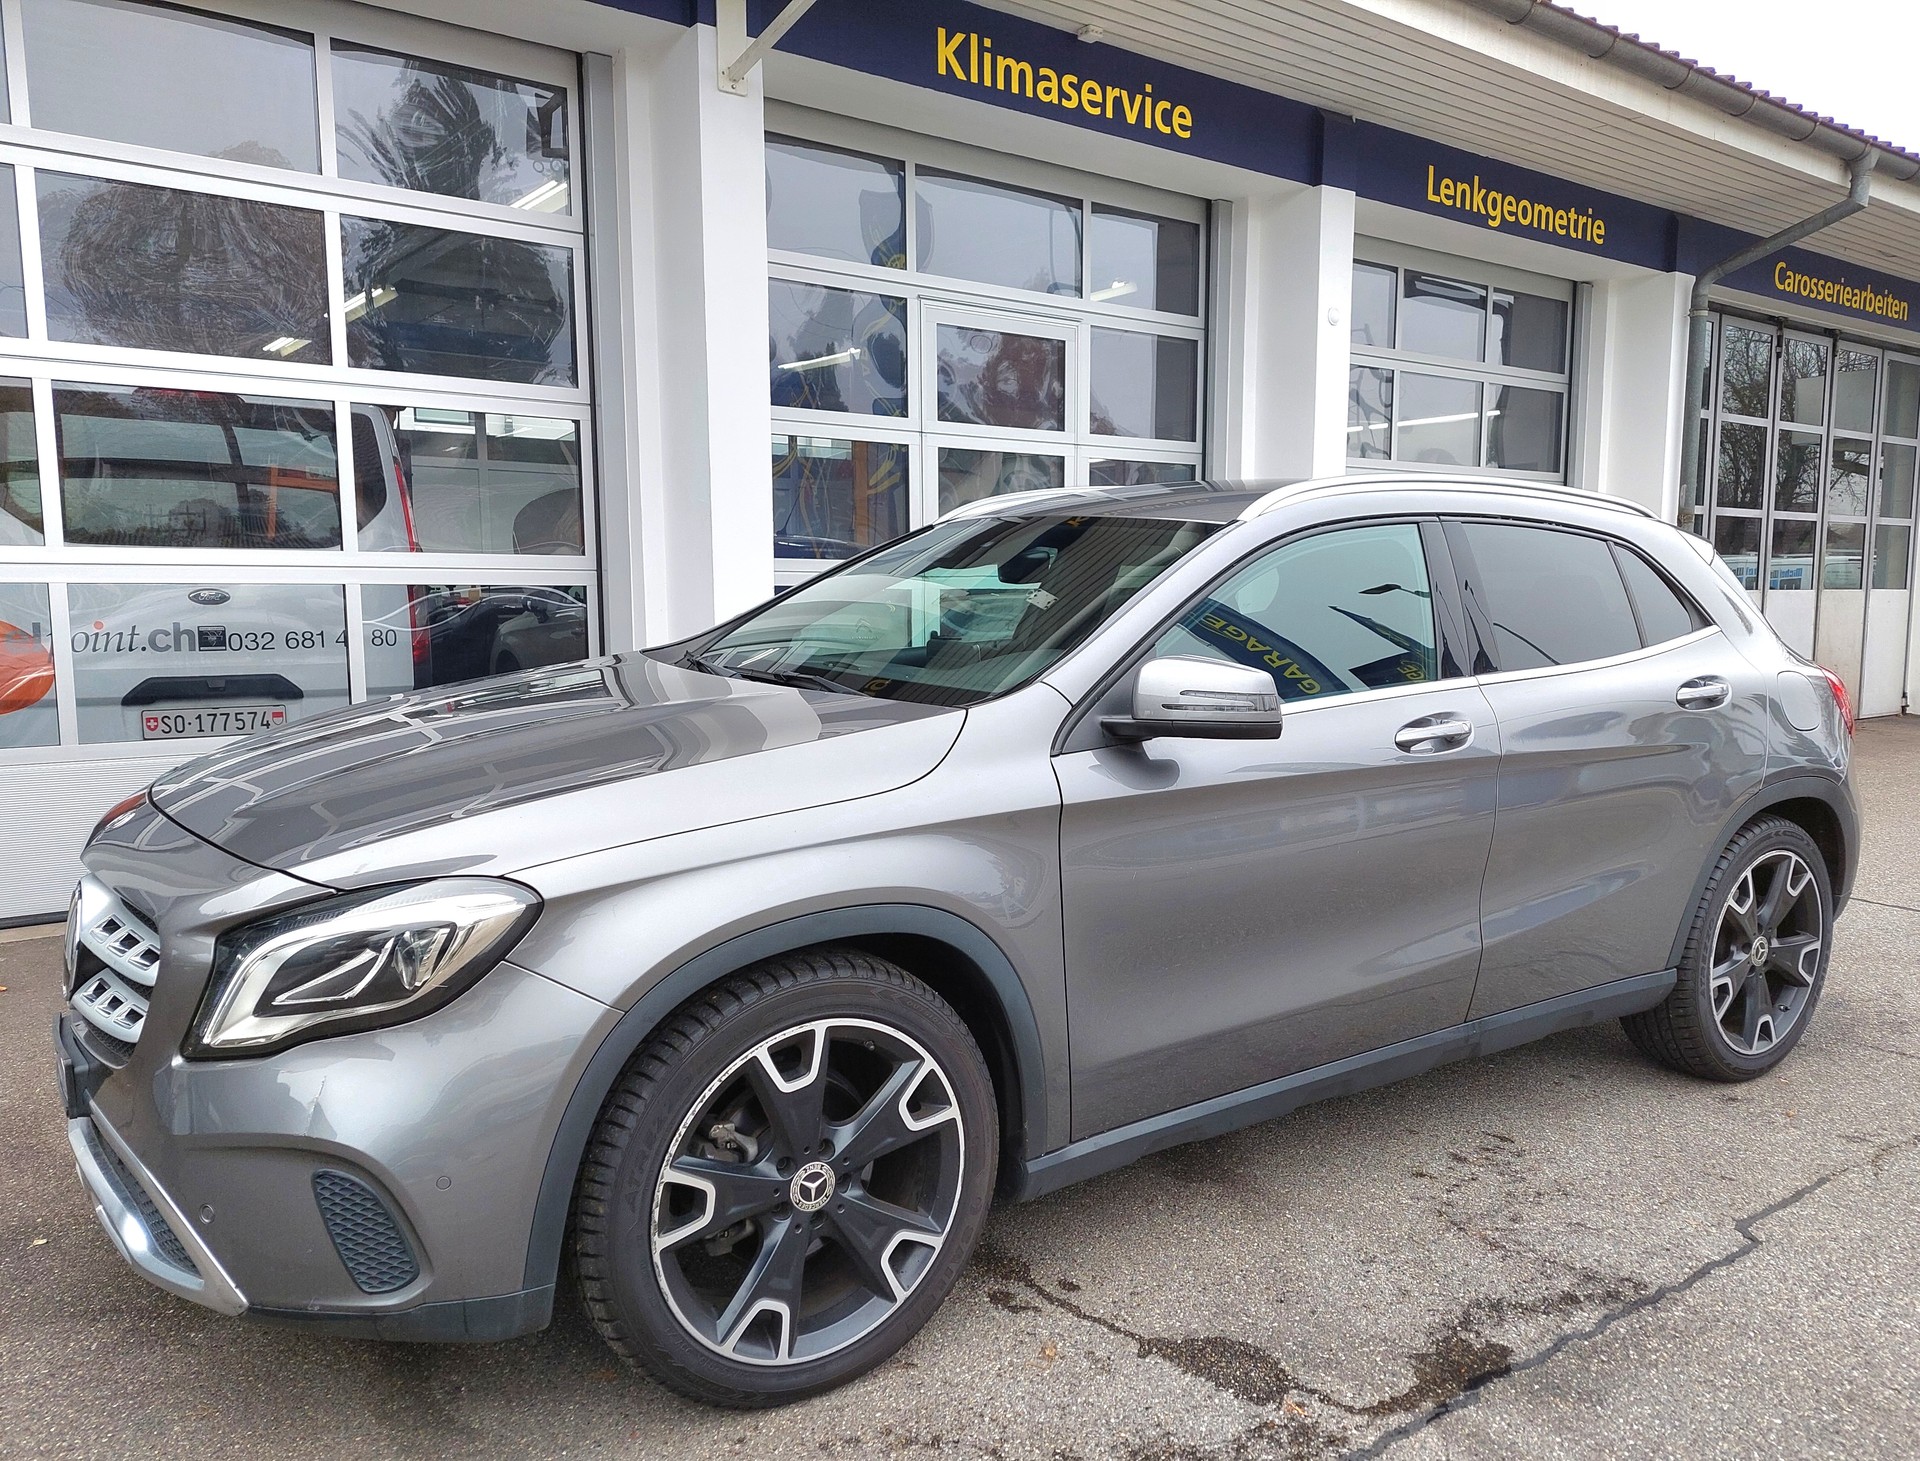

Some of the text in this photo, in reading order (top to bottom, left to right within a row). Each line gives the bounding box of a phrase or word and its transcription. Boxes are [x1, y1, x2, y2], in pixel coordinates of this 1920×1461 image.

[936, 26, 1193, 139] Klimaservice
[1427, 164, 1606, 245] Lenkgeometrie
[1774, 261, 1909, 321] Carosseriearbeiten
[228, 631, 276, 652] 032
[285, 630, 325, 649] 681
[371, 629, 397, 647] 80
[1202, 613, 1322, 696] GARAGE
